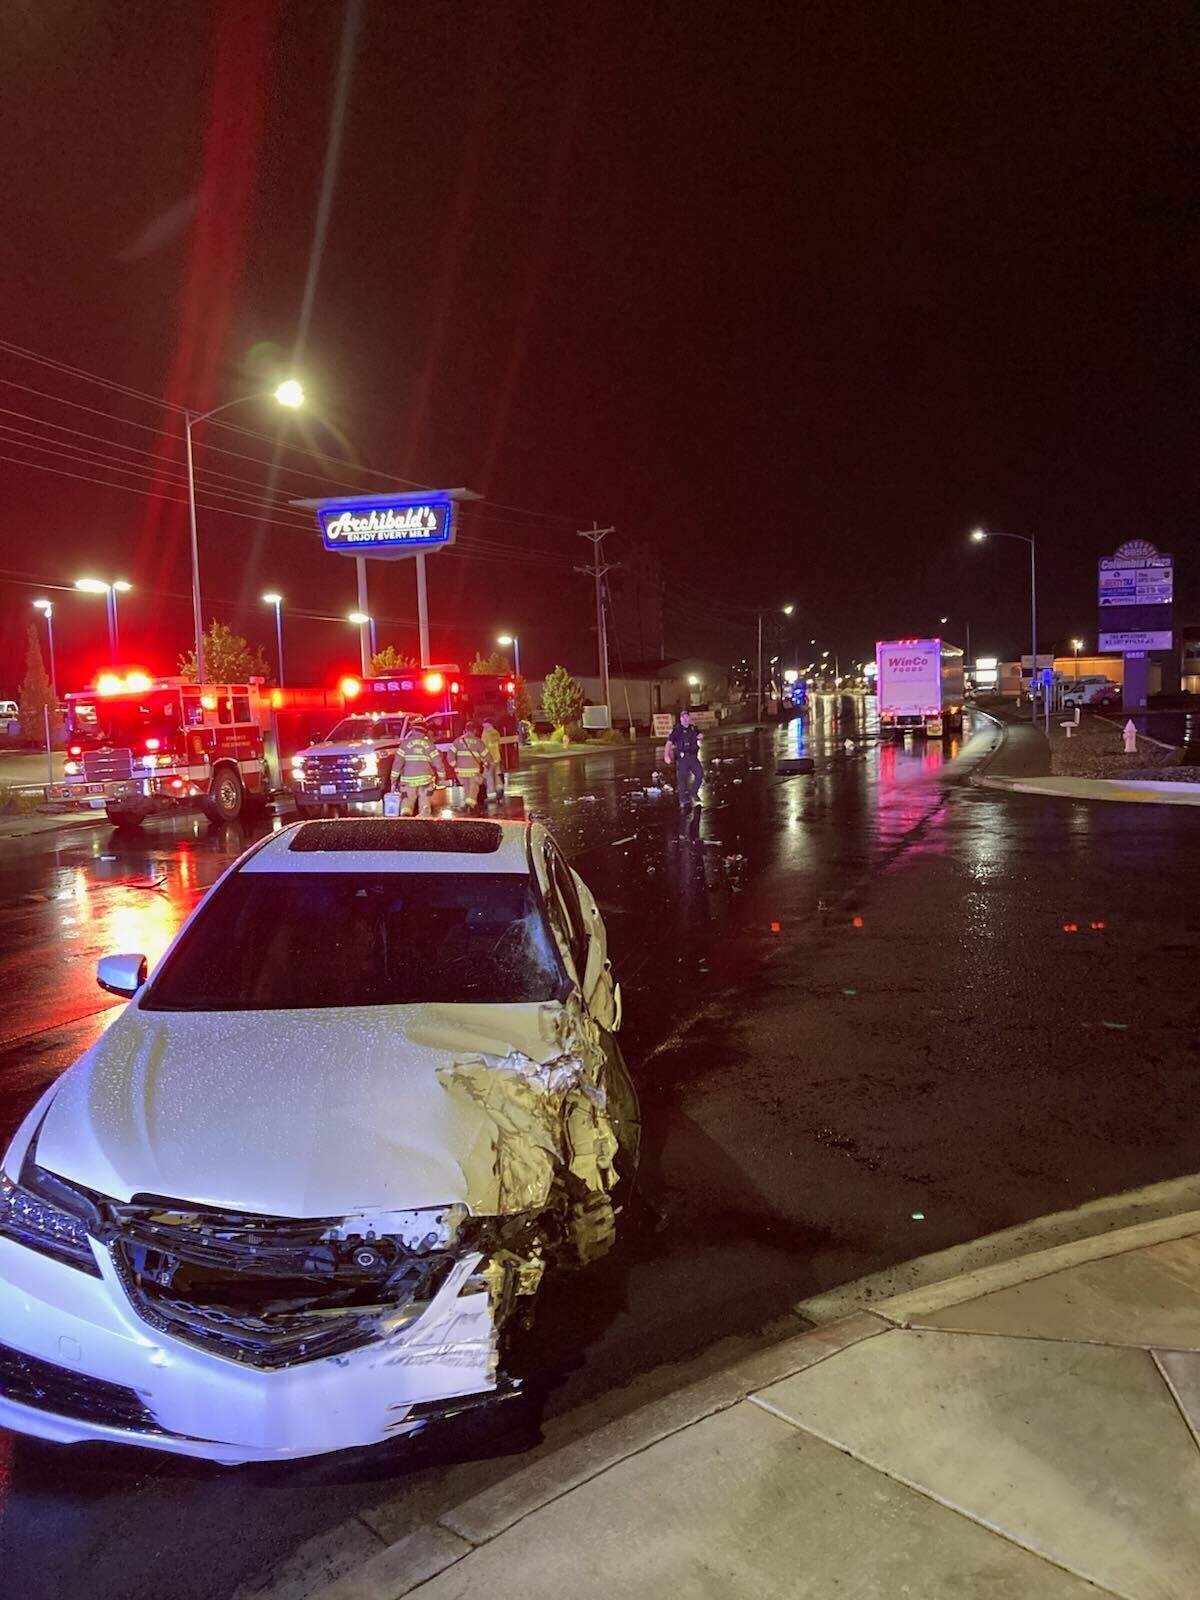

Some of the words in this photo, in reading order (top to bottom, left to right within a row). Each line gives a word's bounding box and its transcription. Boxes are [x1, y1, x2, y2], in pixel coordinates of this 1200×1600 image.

[327, 507, 436, 539] Archibald's
[347, 533, 376, 542] ENJOY
[378, 531, 407, 541] EVERY
[409, 530, 430, 538] MILE
[889, 657, 928, 667] WinCo
